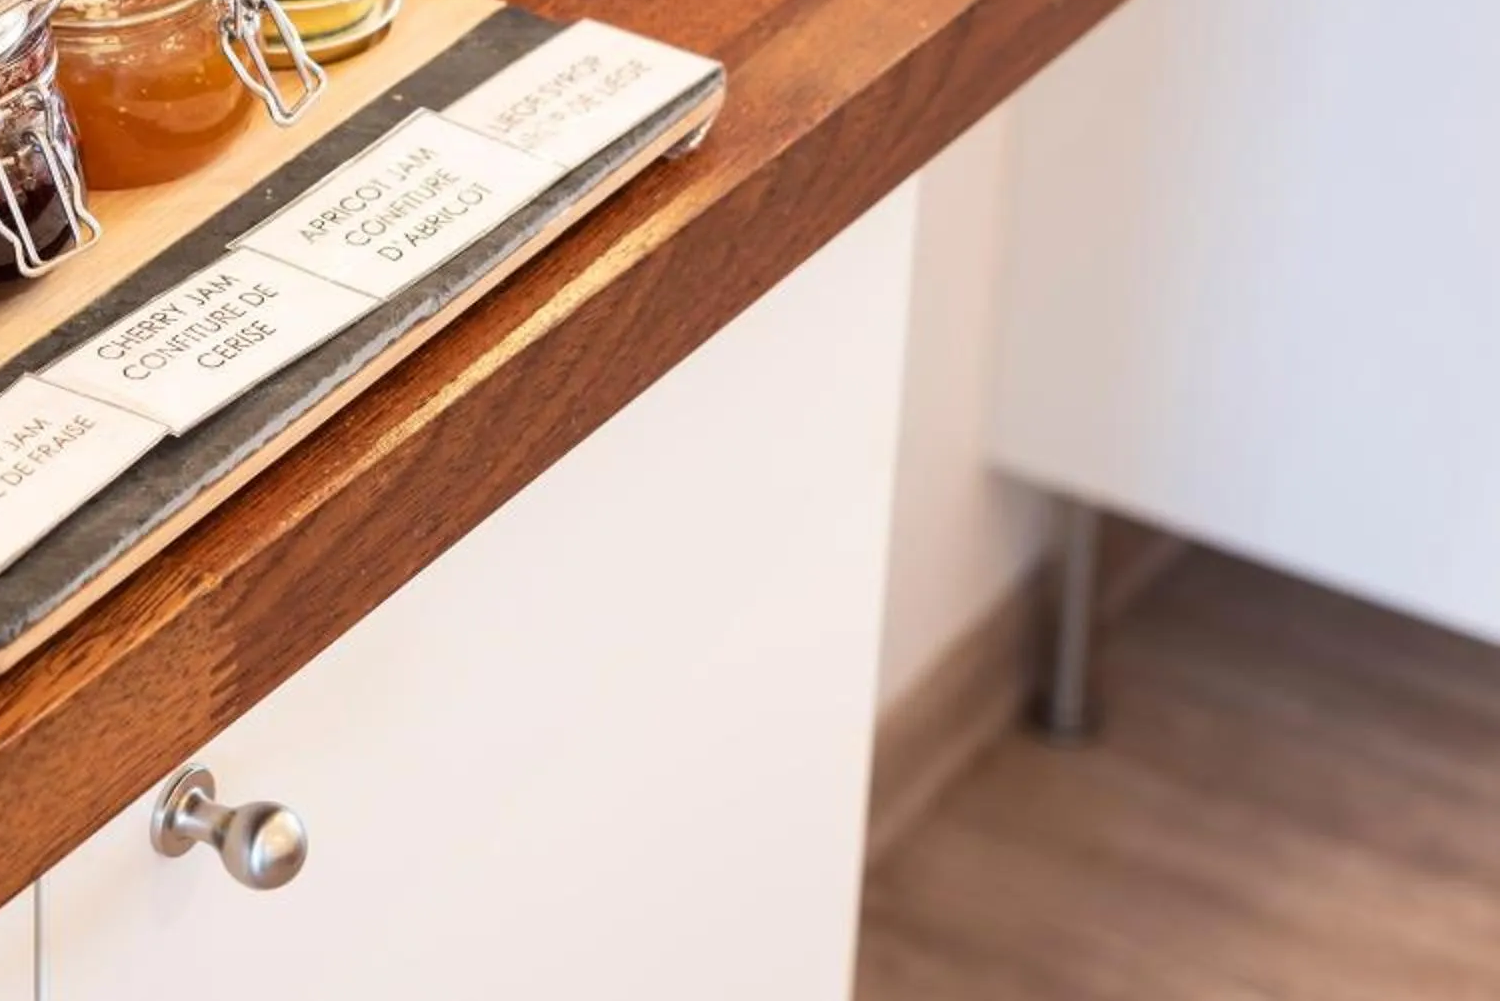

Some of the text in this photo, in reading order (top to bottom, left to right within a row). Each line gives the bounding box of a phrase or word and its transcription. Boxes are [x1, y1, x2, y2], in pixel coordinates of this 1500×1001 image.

[300, 148, 439, 244] APRICOT JAM
[345, 168, 461, 246] CONFITURE
[97, 273, 240, 360] CHERRY JAM
[123, 283, 279, 380] CONFITURE DE
[197, 320, 277, 369] CERISE
[0, 461, 35, 486] DE
[28, 414, 96, 465] FRAISE
[4, 417, 52, 452] JAM
